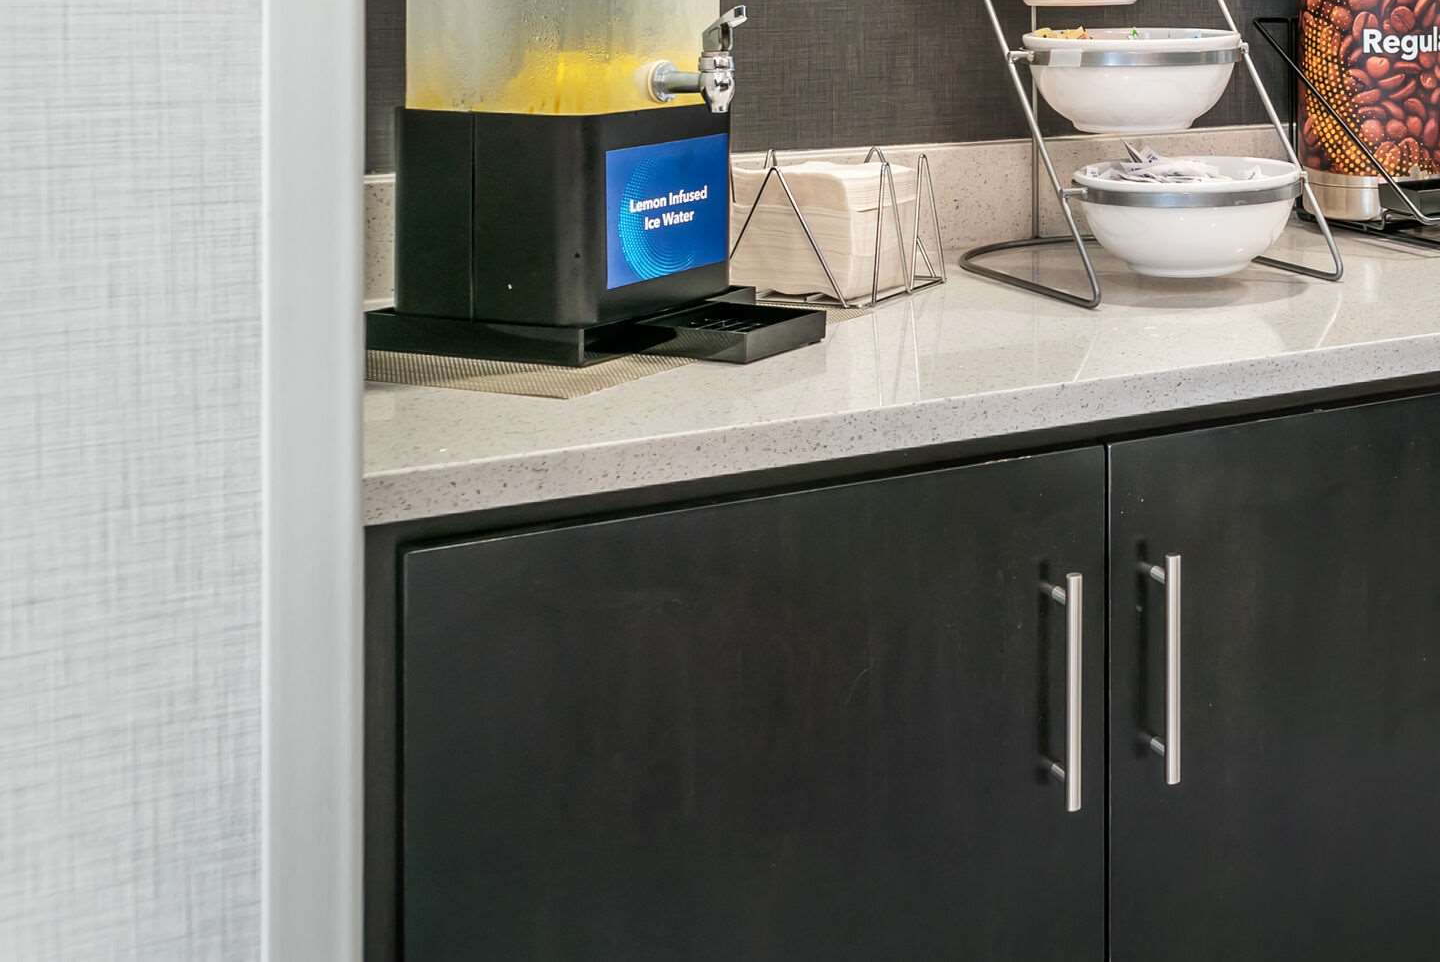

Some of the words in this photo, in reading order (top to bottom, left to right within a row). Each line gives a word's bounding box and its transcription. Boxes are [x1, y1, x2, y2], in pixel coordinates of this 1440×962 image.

[630, 196, 666, 213] Lemon
[669, 185, 708, 205] Infused
[645, 216, 660, 230] Ice
[662, 210, 695, 226] Water
